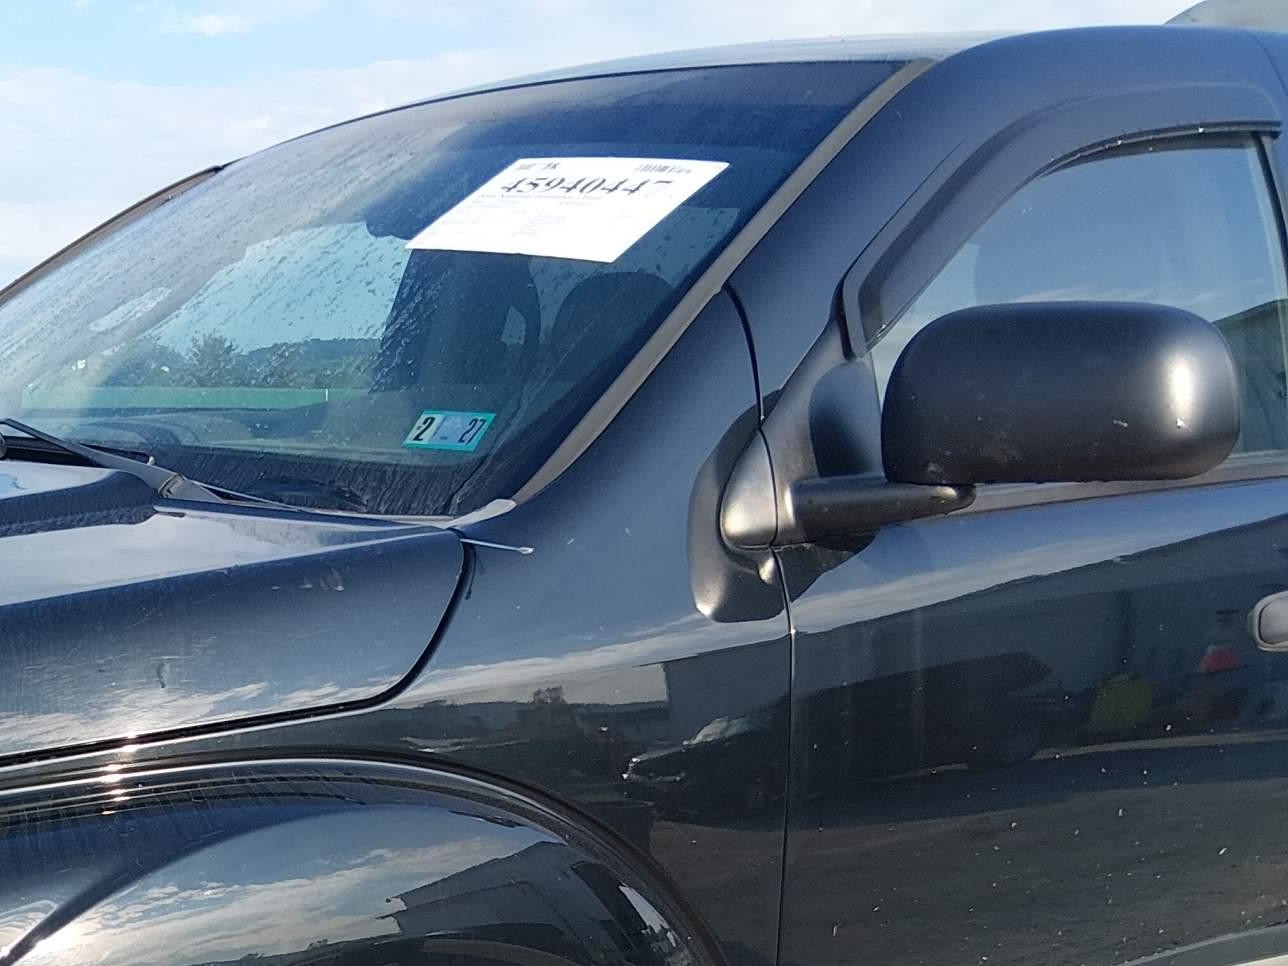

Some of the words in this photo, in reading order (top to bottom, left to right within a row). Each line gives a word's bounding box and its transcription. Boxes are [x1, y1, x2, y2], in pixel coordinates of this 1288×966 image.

[500, 177, 675, 196] 45940447
[412, 416, 436, 442] 2
[457, 418, 488, 446] 27
